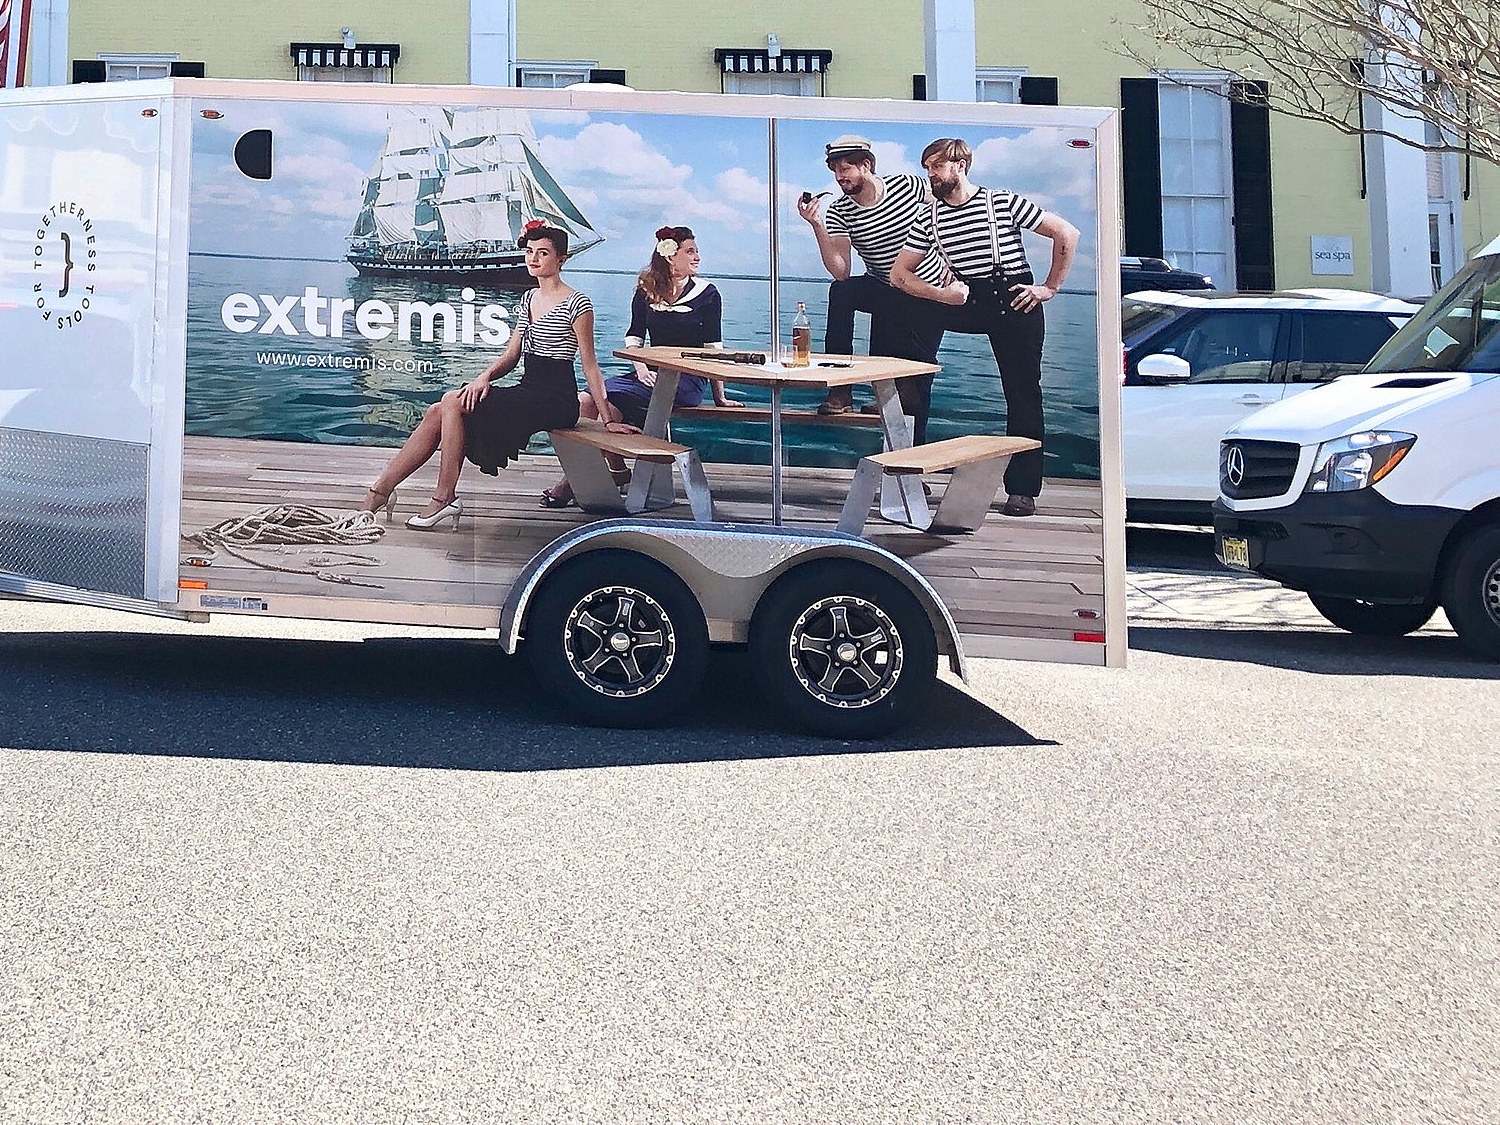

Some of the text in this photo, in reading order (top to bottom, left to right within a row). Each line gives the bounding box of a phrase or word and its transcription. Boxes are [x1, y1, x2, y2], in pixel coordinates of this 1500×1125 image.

[33, 201, 97, 329] TOOLS FOR TOGETHERNESS
[1315, 251, 1351, 263] sea spa
[221, 286, 510, 346] extremis
[256, 350, 434, 374] www.extremis.com
